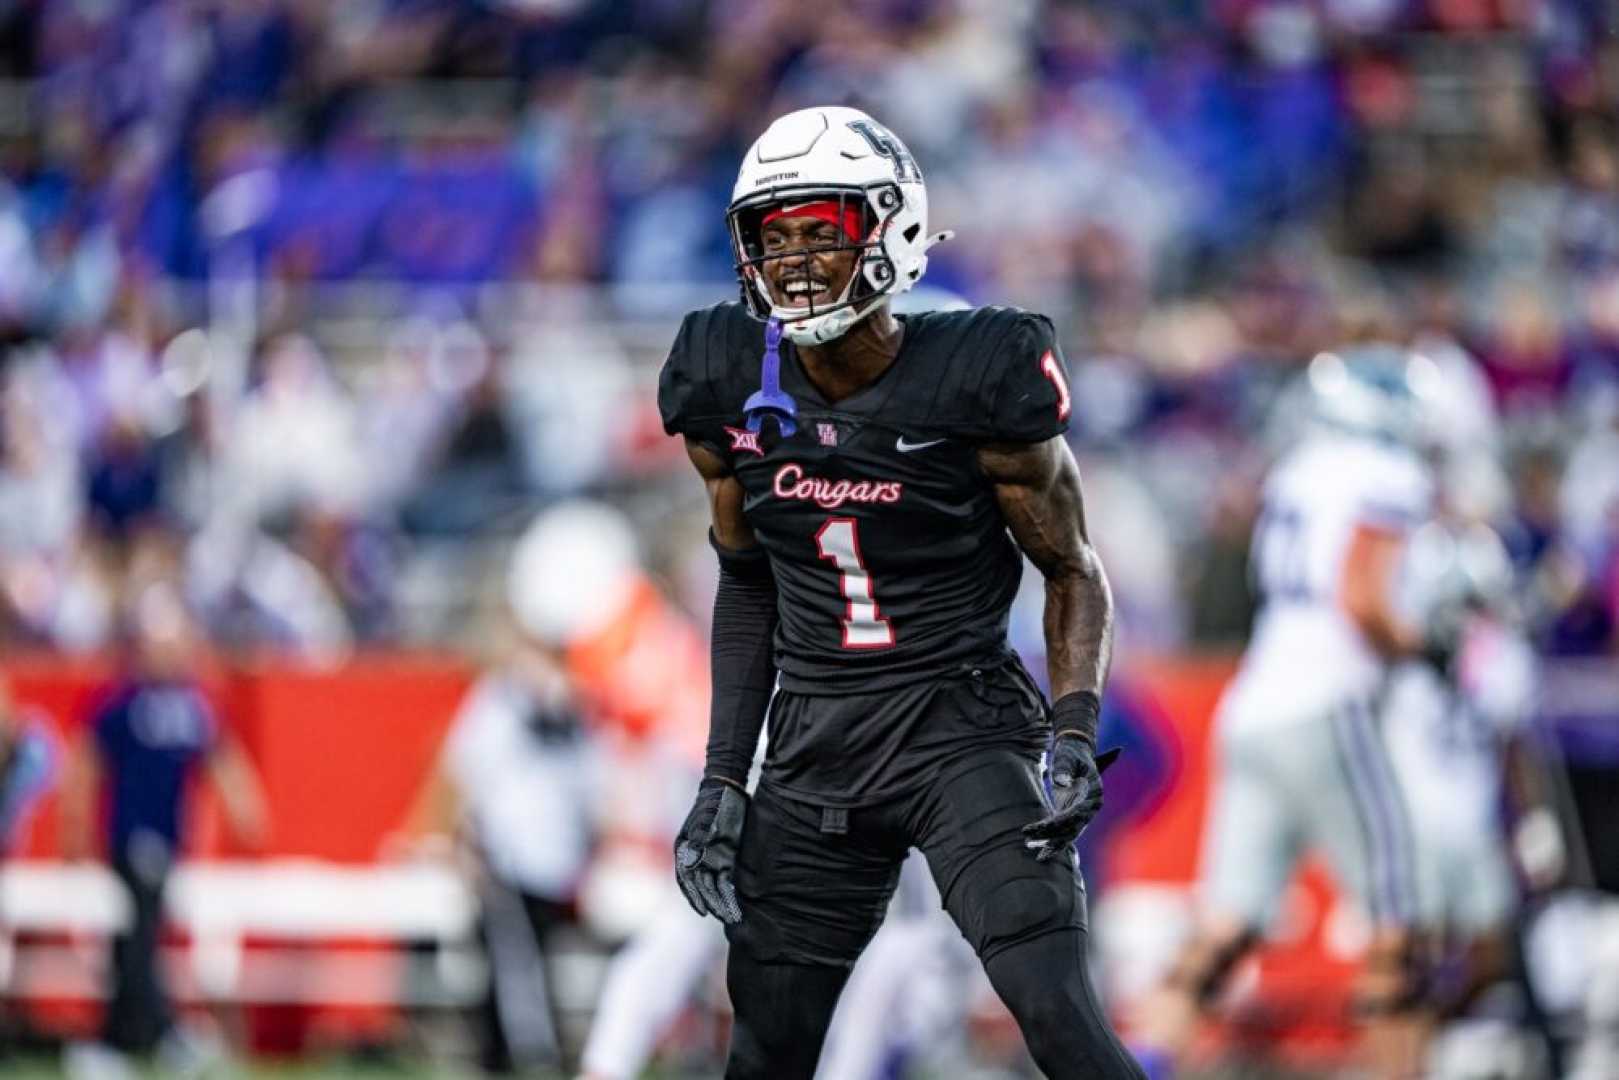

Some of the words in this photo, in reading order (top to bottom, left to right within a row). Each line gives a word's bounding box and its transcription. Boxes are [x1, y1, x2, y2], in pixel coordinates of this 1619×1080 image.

[1040, 347, 1072, 423] 1
[774, 462, 902, 509] Cougars
[815, 516, 895, 648] 1
